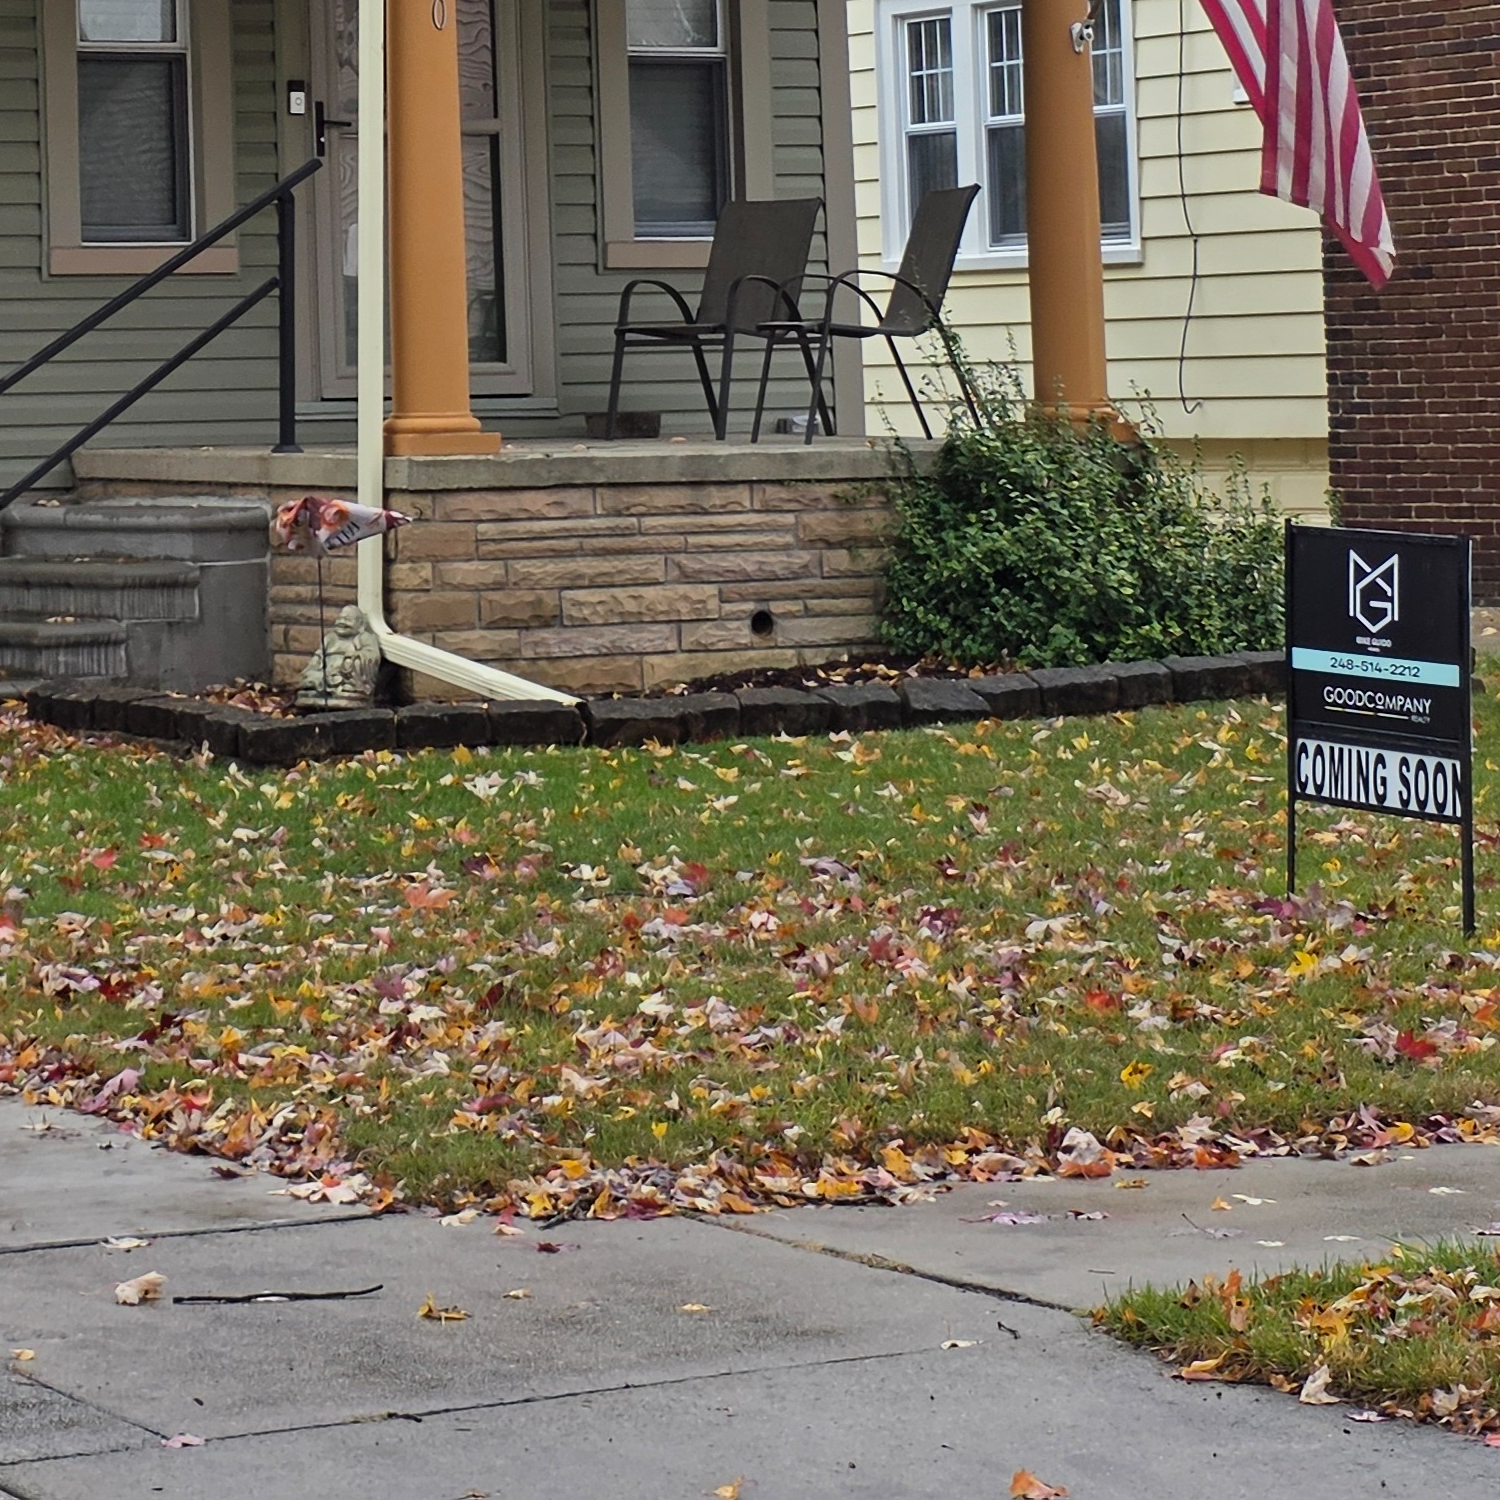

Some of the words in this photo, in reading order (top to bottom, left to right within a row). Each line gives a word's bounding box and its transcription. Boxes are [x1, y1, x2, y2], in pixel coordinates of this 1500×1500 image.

[1330, 657, 1421, 678] 248-514-2212
[1297, 741, 1388, 806] COMING
[1398, 756, 1462, 817] SOON
